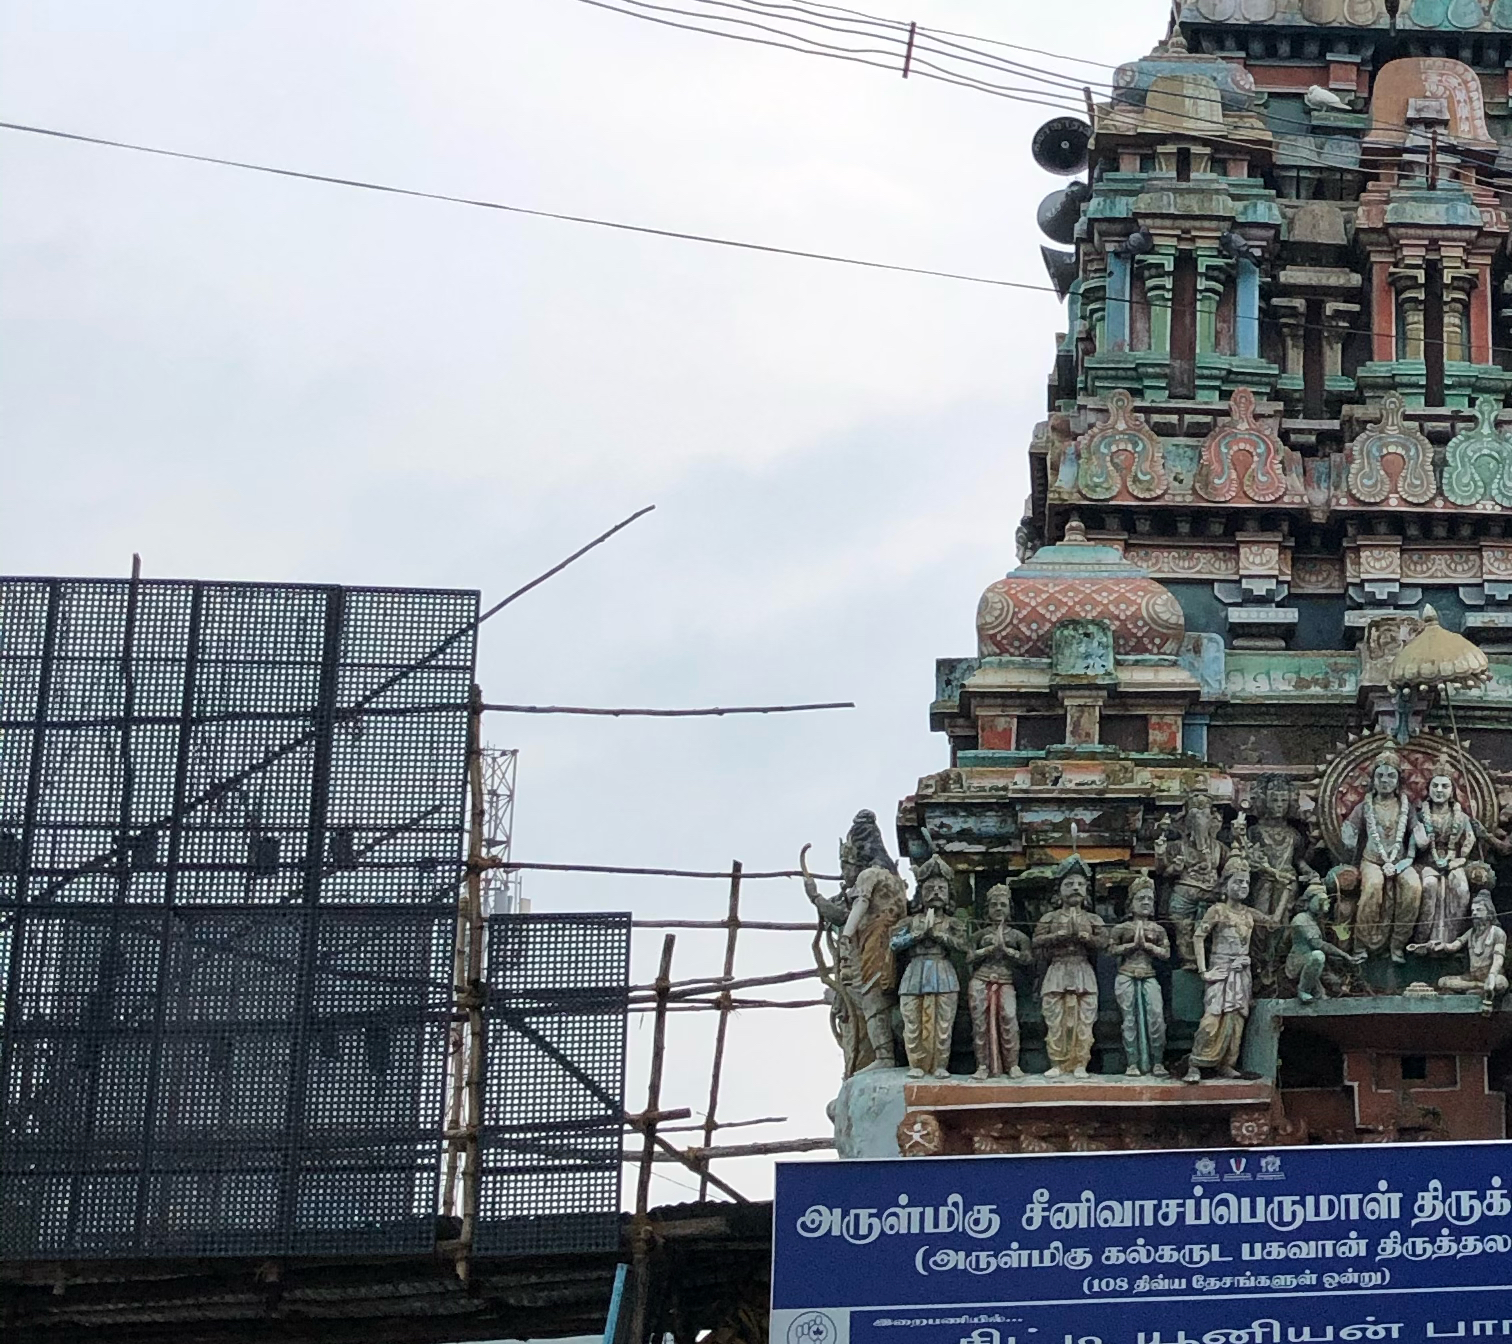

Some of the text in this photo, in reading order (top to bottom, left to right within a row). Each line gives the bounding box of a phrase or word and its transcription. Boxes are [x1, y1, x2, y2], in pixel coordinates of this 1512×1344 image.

[796, 1193, 1000, 1244] அருள்மிகு
[1021, 1179, 1403, 1232] சீனிவாசப்பெருமாள்
[914, 1241, 1093, 1275] (அருள்மிகு
[1101, 1237, 1233, 1269] கல்கருட
[1241, 1230, 1368, 1261] பகவான்
[1082, 1267, 1391, 1294] (108 திவ்ய தேசங்களுள் ஒன்று)
